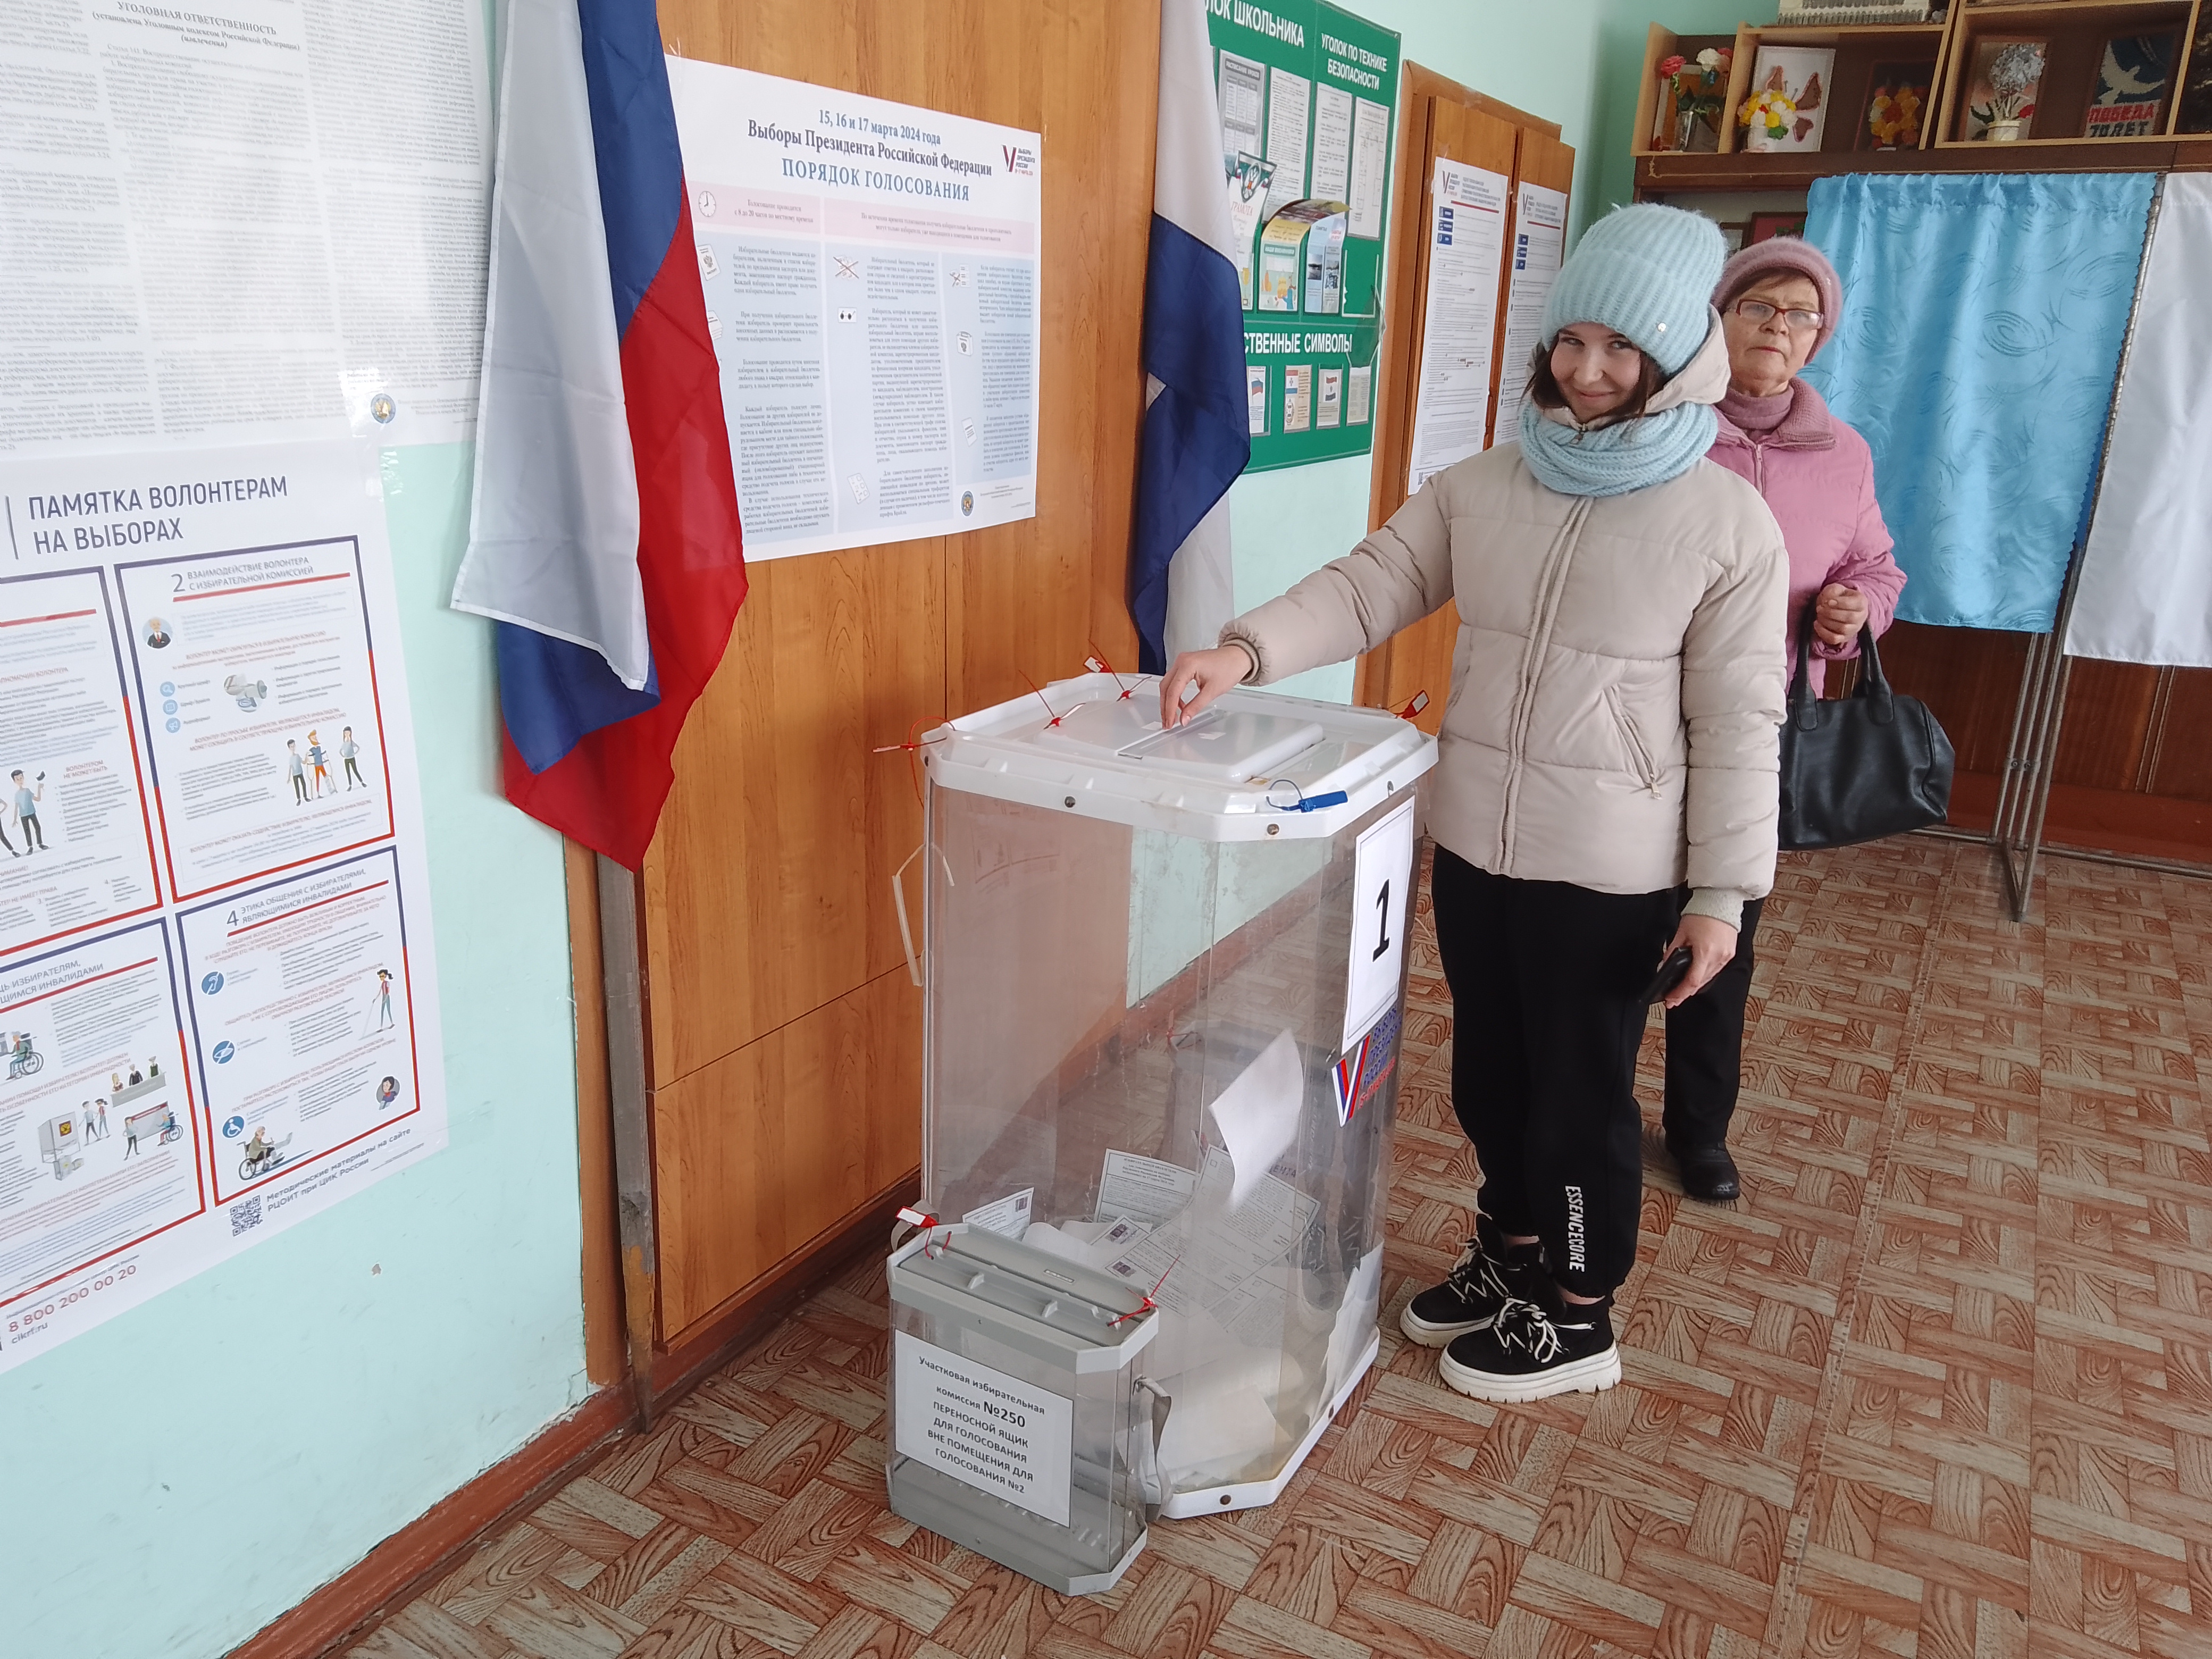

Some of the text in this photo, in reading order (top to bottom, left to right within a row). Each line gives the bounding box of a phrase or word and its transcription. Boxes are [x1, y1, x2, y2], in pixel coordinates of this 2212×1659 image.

[92, 11, 300, 51] (установлена Уголовным кодексом Российской Федерации)
[117, 1, 277, 35] УГОЛОВНАЯ ОТВЕТСТВЕННОСТЬ
[1205, 0, 1304, 48] ЛОК ШКОЛЬНИКА
[180, 34, 228, 48] (извлечения)
[1321, 32, 1387, 72] УГОЛОК ПО ТЕХНИКЕ
[1328, 57, 1379, 90] БЕЗОПАСНОСТИ
[818, 109, 941, 146] 15, 16 и 17 марта 2024 года
[2088, 103, 2154, 124] ПОБЕДА
[748, 119, 992, 178] Выборы Президента Российской Федерации
[781, 157, 969, 202] ПОРЯДОК ГОЛОСОВАНИЯ
[748, 199, 801, 212] Голосование проводится
[775, 214, 794, 222] местному
[1231, 201, 1253, 216] ГРАМОТА
[1244, 332, 1353, 354] СТВЕННЫЕ СИМВОЛЫ
[29, 475, 288, 520] ПАМЯТКА ВОЛОНТЕРАМ
[33, 517, 184, 555] НА ВЫБОРАХ
[171, 573, 186, 592] 2
[187, 556, 309, 580] ВЗАИМОДЕЙСТВИЕ ВОЛОНТЕРА
[197, 572, 265, 590] ИЗБИРАТЕЛЬНОЙ
[266, 566, 314, 581] КОМИССИЕЙ
[66, 759, 104, 773] ВОЛОНТЕРОМ
[94, 766, 107, 775] БЫТЬ
[0, 865, 28, 877] НИМАНИЕ!
[240, 900, 265, 914] ЭТИКА
[266, 889, 303, 905] ОБЩЕНИЯ
[310, 868, 366, 891] ИЗБИРАТЕЛЯМИ,
[242, 882, 353, 924] ЯВЛЯЮЩИМИСЯ ИНВАЛИДАМИ
[226, 910, 239, 926] 4
[1372, 878, 1390, 962] 1
[0, 963, 104, 1004] ЩИМСЯ ИНВАЛИДАМИ
[12, 960, 81, 988] ИЗБИРАТЕЛЯМ,
[266, 1128, 411, 1202] Методические материалы на сайте
[1270, 1164, 1297, 1178] ЕНТА
[267, 1158, 369, 1212] РЦОИТ при ЦИК России
[1565, 1185, 1585, 1272] ESSENCECORE
[9, 1264, 137, 1333] 8 800 200 00 20
[11, 1322, 48, 1344] cikrf.ru
[919, 1355, 1045, 1415] Участковая избирательная
[933, 1401, 1028, 1448] ПЕРЕНОСНОЙ ЯЩИК
[936, 1386, 1025, 1428] комиссия №250
[927, 1429, 1033, 1482] ВНЕ ПОМЕЩЕНИЯ ДЛЯ
[933, 1417, 1027, 1463] ДЛЯ ГОЛОСОВАНИЯ
[935, 1447, 1025, 1494] ГОЛОСОВАНИЯ №2
